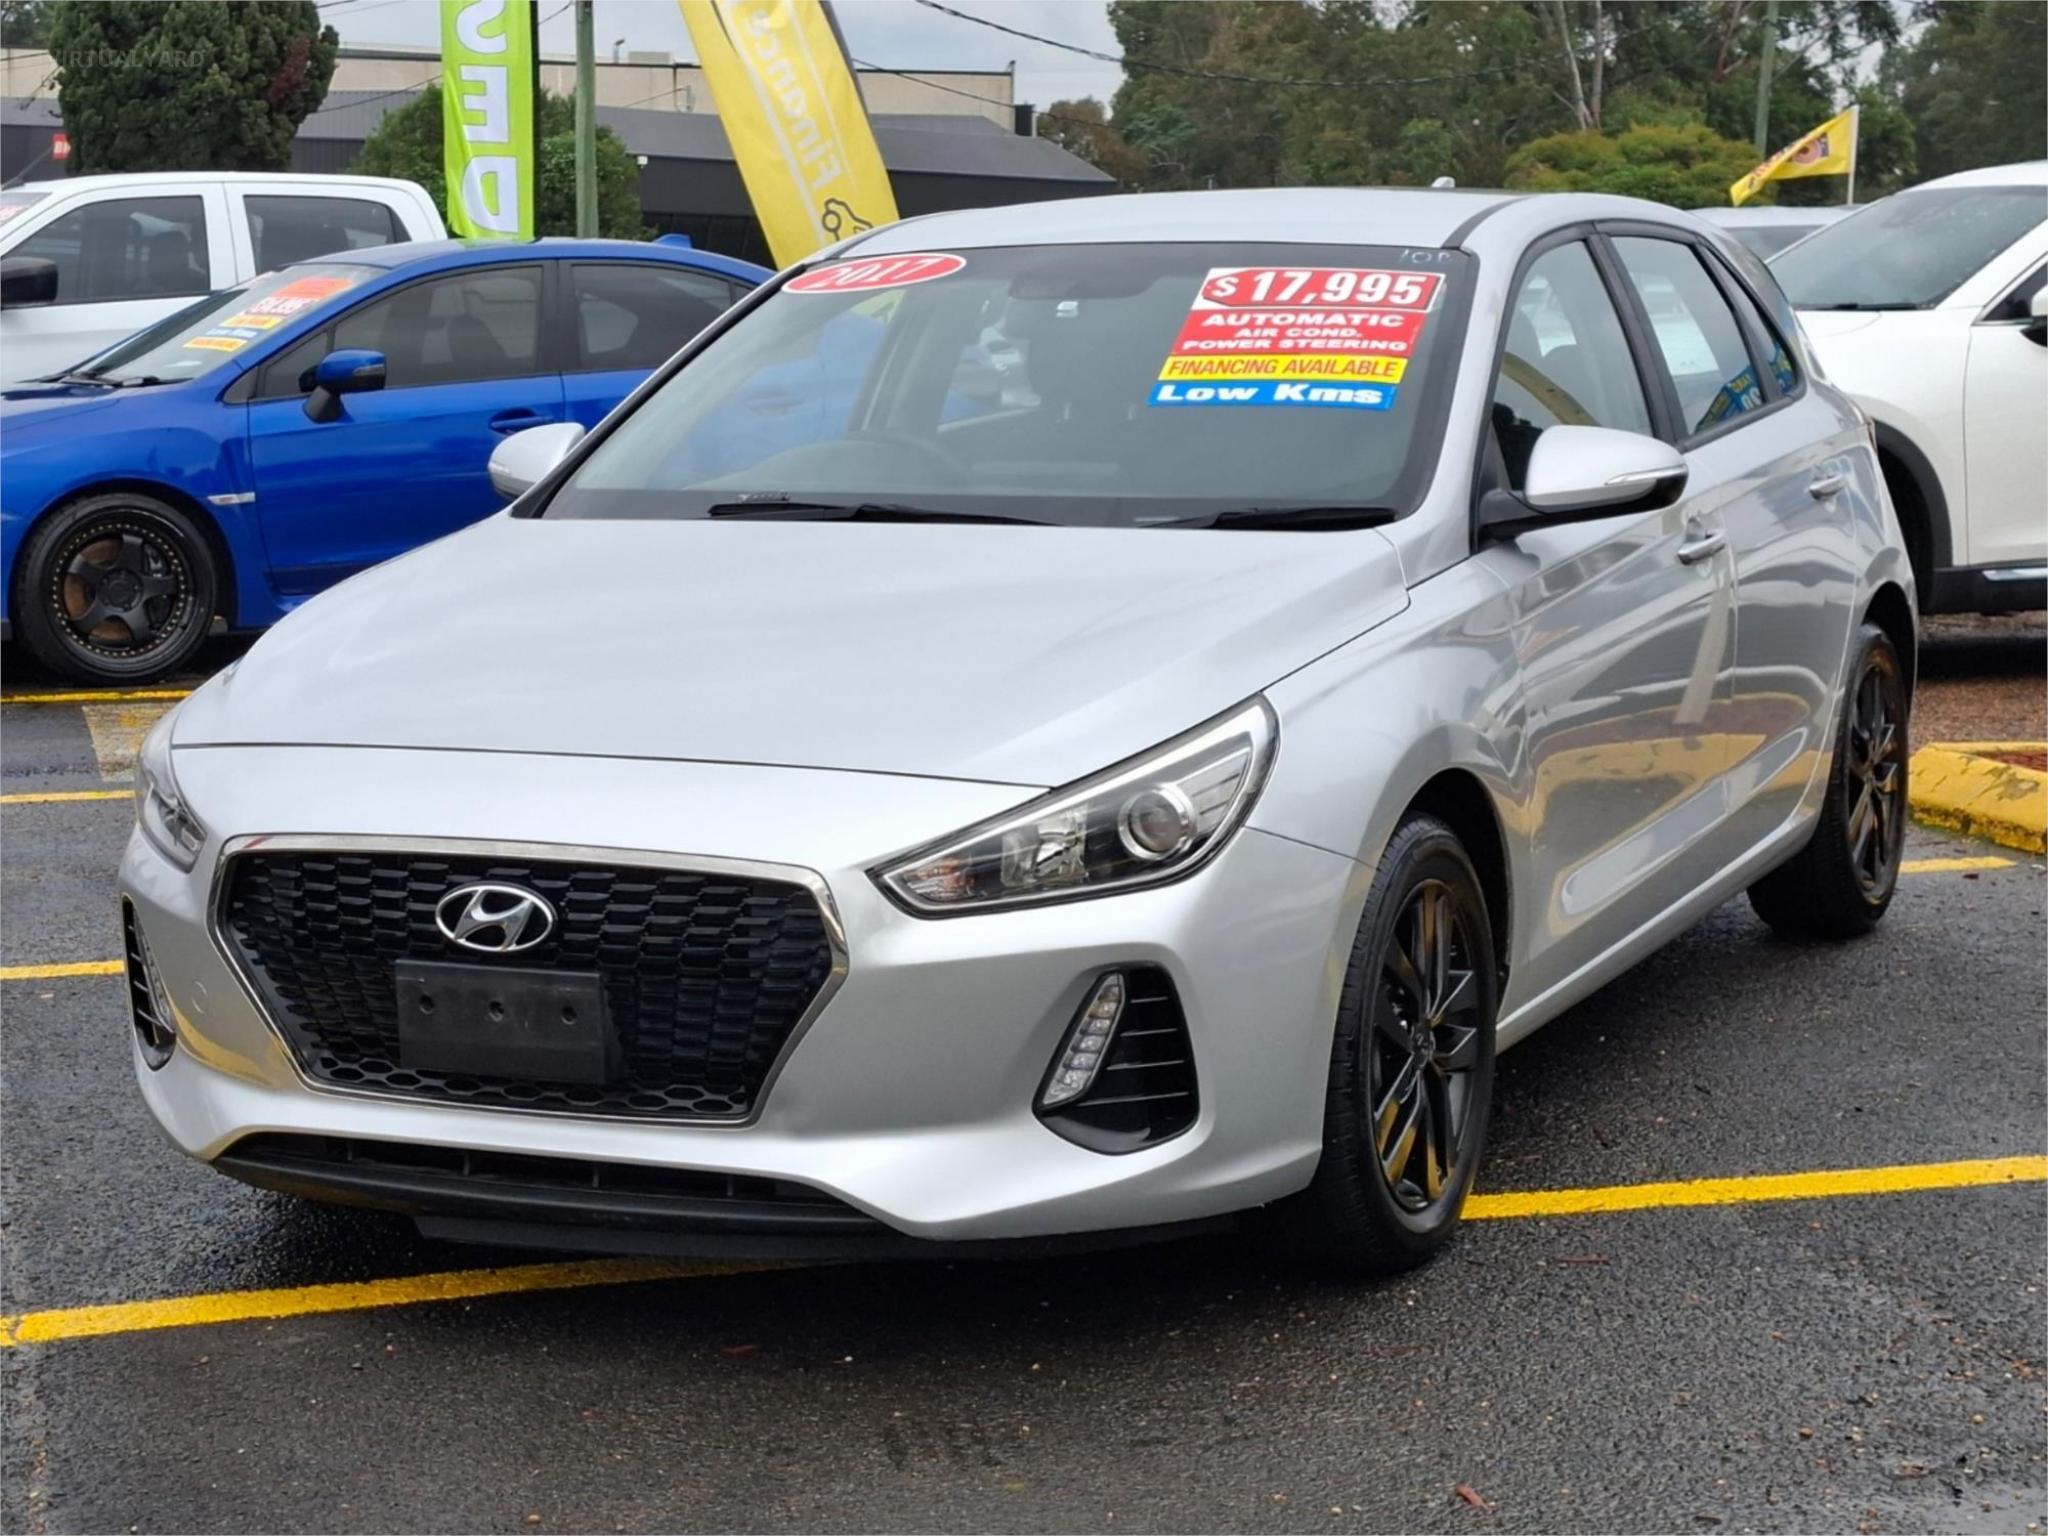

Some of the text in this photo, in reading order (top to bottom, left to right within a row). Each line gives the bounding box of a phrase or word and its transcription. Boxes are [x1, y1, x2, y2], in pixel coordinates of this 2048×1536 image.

[802, 257, 945, 290] 2017
[1202, 313, 1405, 328] AUTOMATIC
[1234, 327, 1363, 338] AIR COND.
[1182, 339, 1408, 352] POWER STEERING
[1168, 358, 1399, 378] FINANCING AVAILABLE
[1156, 383, 1384, 404] Low Kms
